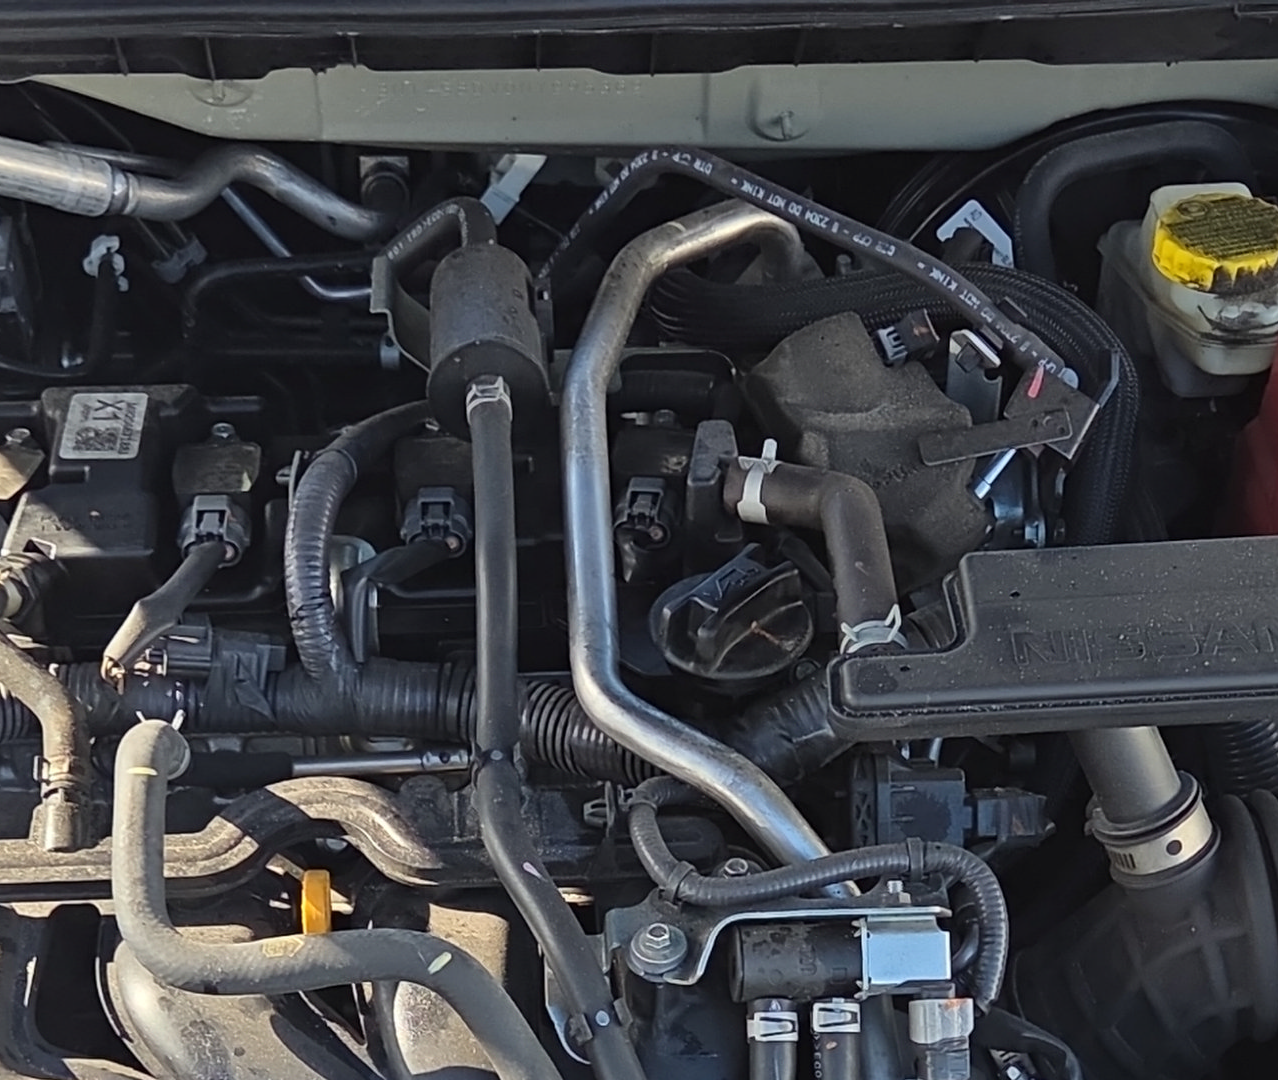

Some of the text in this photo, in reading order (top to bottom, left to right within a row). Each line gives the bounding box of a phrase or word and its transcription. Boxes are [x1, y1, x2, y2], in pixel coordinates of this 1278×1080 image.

[740, 179, 766, 199] KINK
[766, 192, 786, 210] NOT
[787, 201, 803, 217] DO
[928, 266, 960, 293] KINK
[91, 398, 126, 421] X1
